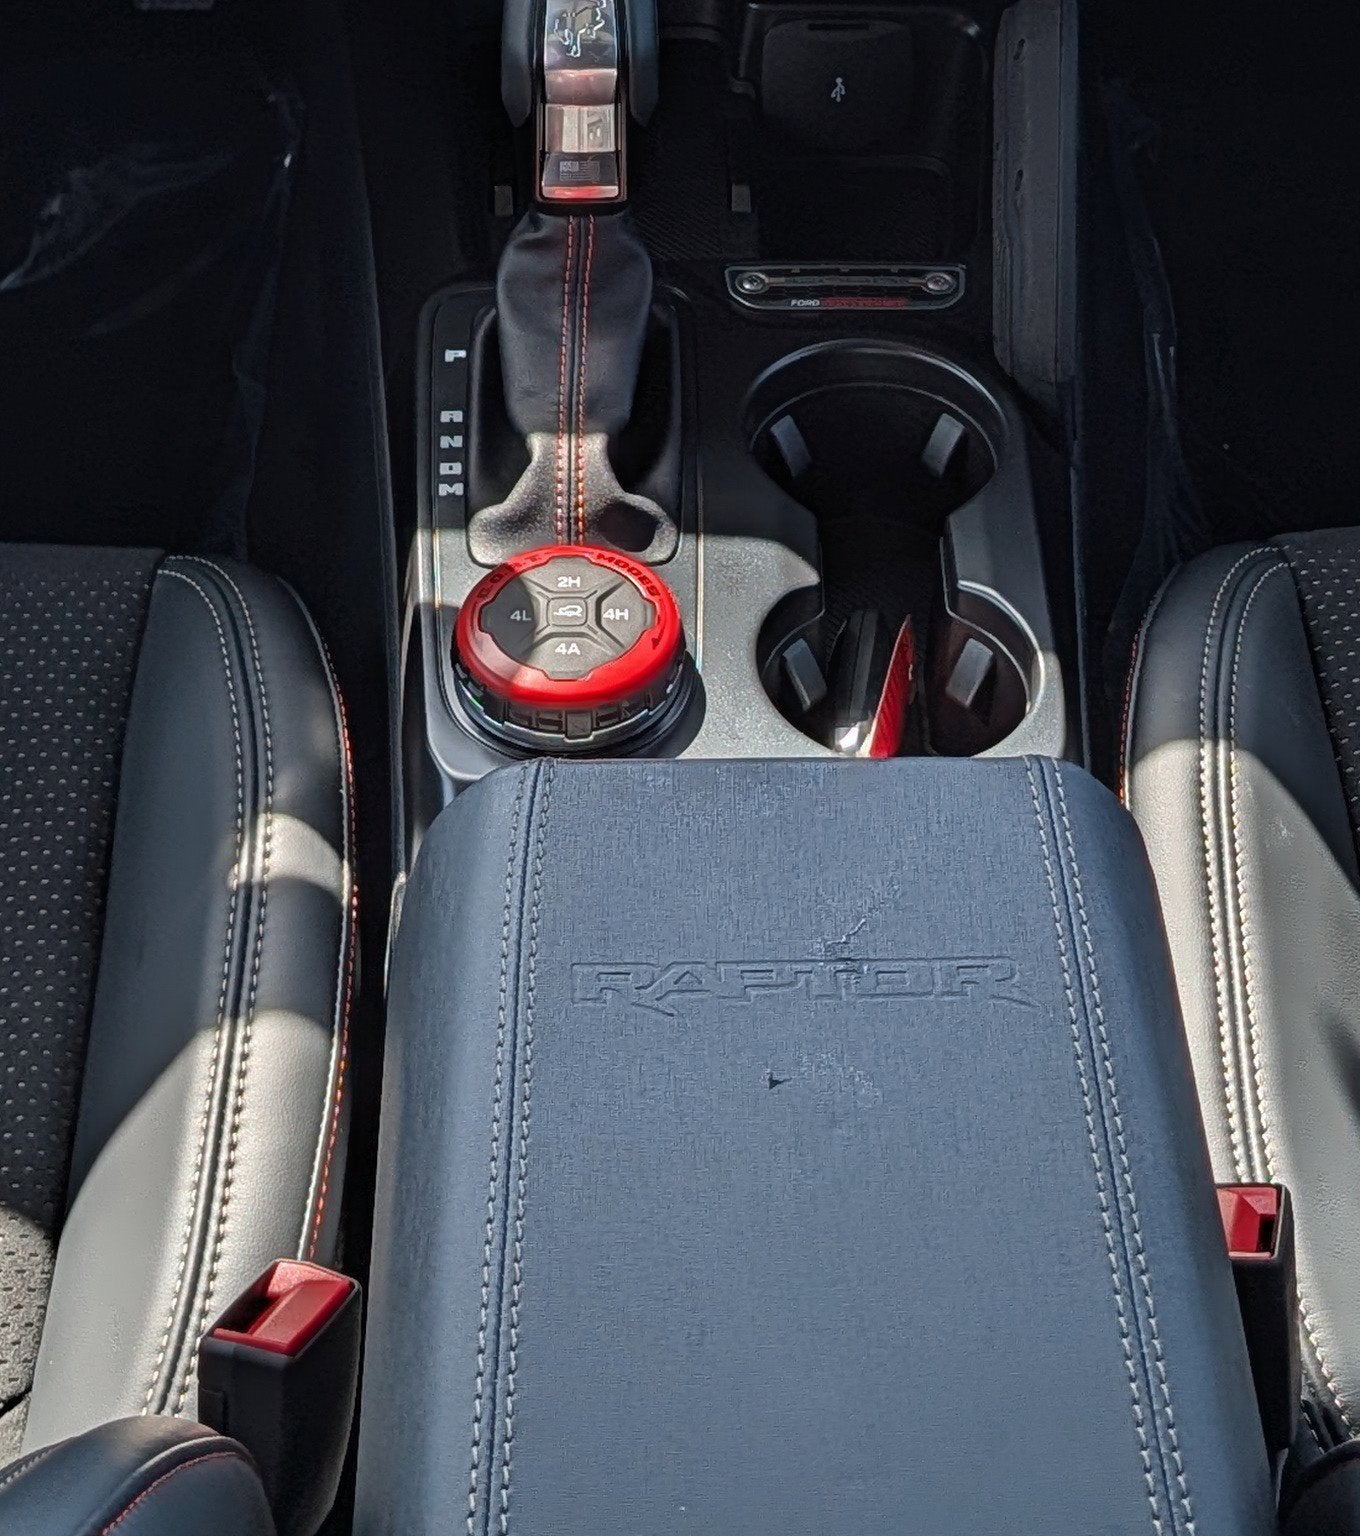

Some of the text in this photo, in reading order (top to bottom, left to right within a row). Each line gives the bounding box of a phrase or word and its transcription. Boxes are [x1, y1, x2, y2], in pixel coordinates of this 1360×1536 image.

[445, 349, 467, 363] P
[440, 435, 463, 449] N
[438, 482, 464, 496] M
[557, 575, 581, 588] 2H
[596, 553, 661, 597] MODES
[510, 610, 532, 621] 4L
[602, 608, 629, 621] 4H
[555, 642, 581, 656] 4A
[571, 956, 1041, 1017] RAPTOR
